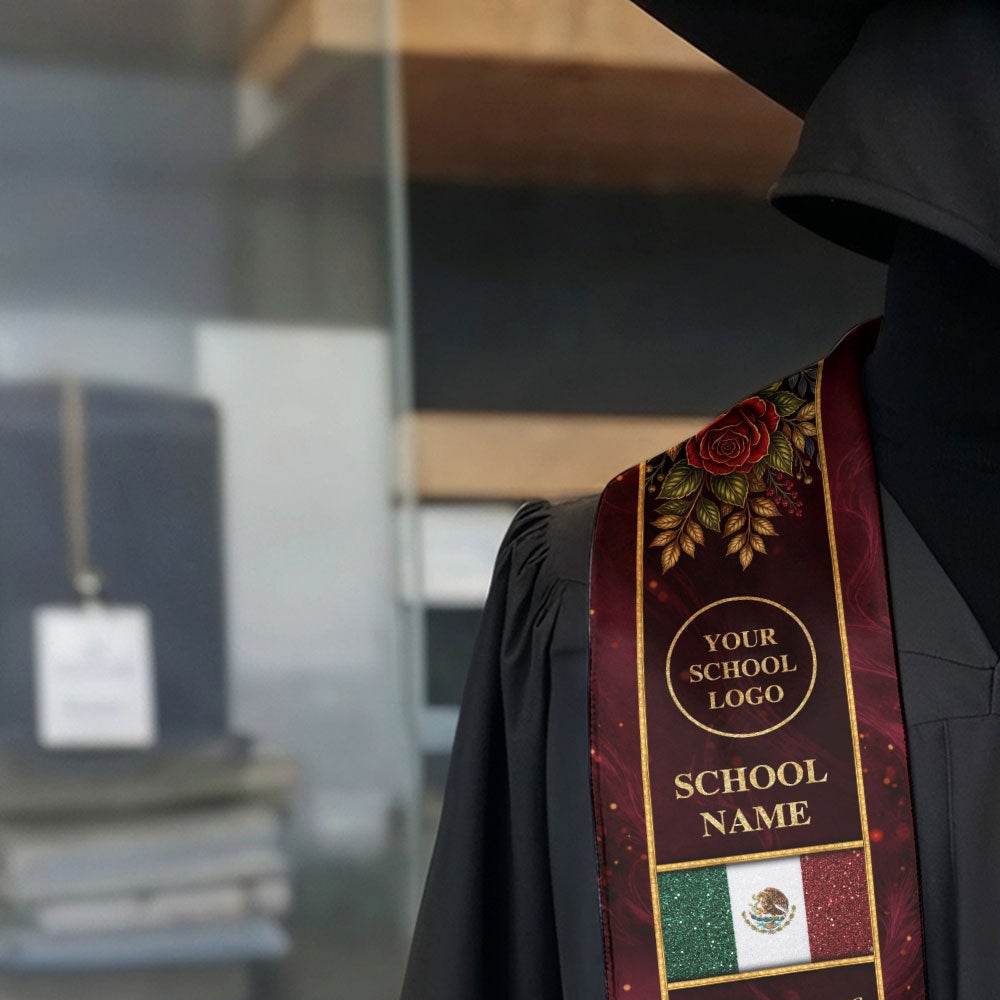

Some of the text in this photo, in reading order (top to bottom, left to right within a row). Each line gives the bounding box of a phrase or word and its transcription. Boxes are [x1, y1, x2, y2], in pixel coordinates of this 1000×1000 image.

[703, 628, 779, 652] YOUR
[689, 654, 797, 683] SCHOOL
[707, 684, 785, 710] LOGO
[674, 758, 828, 800] SCHOOL
[700, 800, 811, 838] NAME
